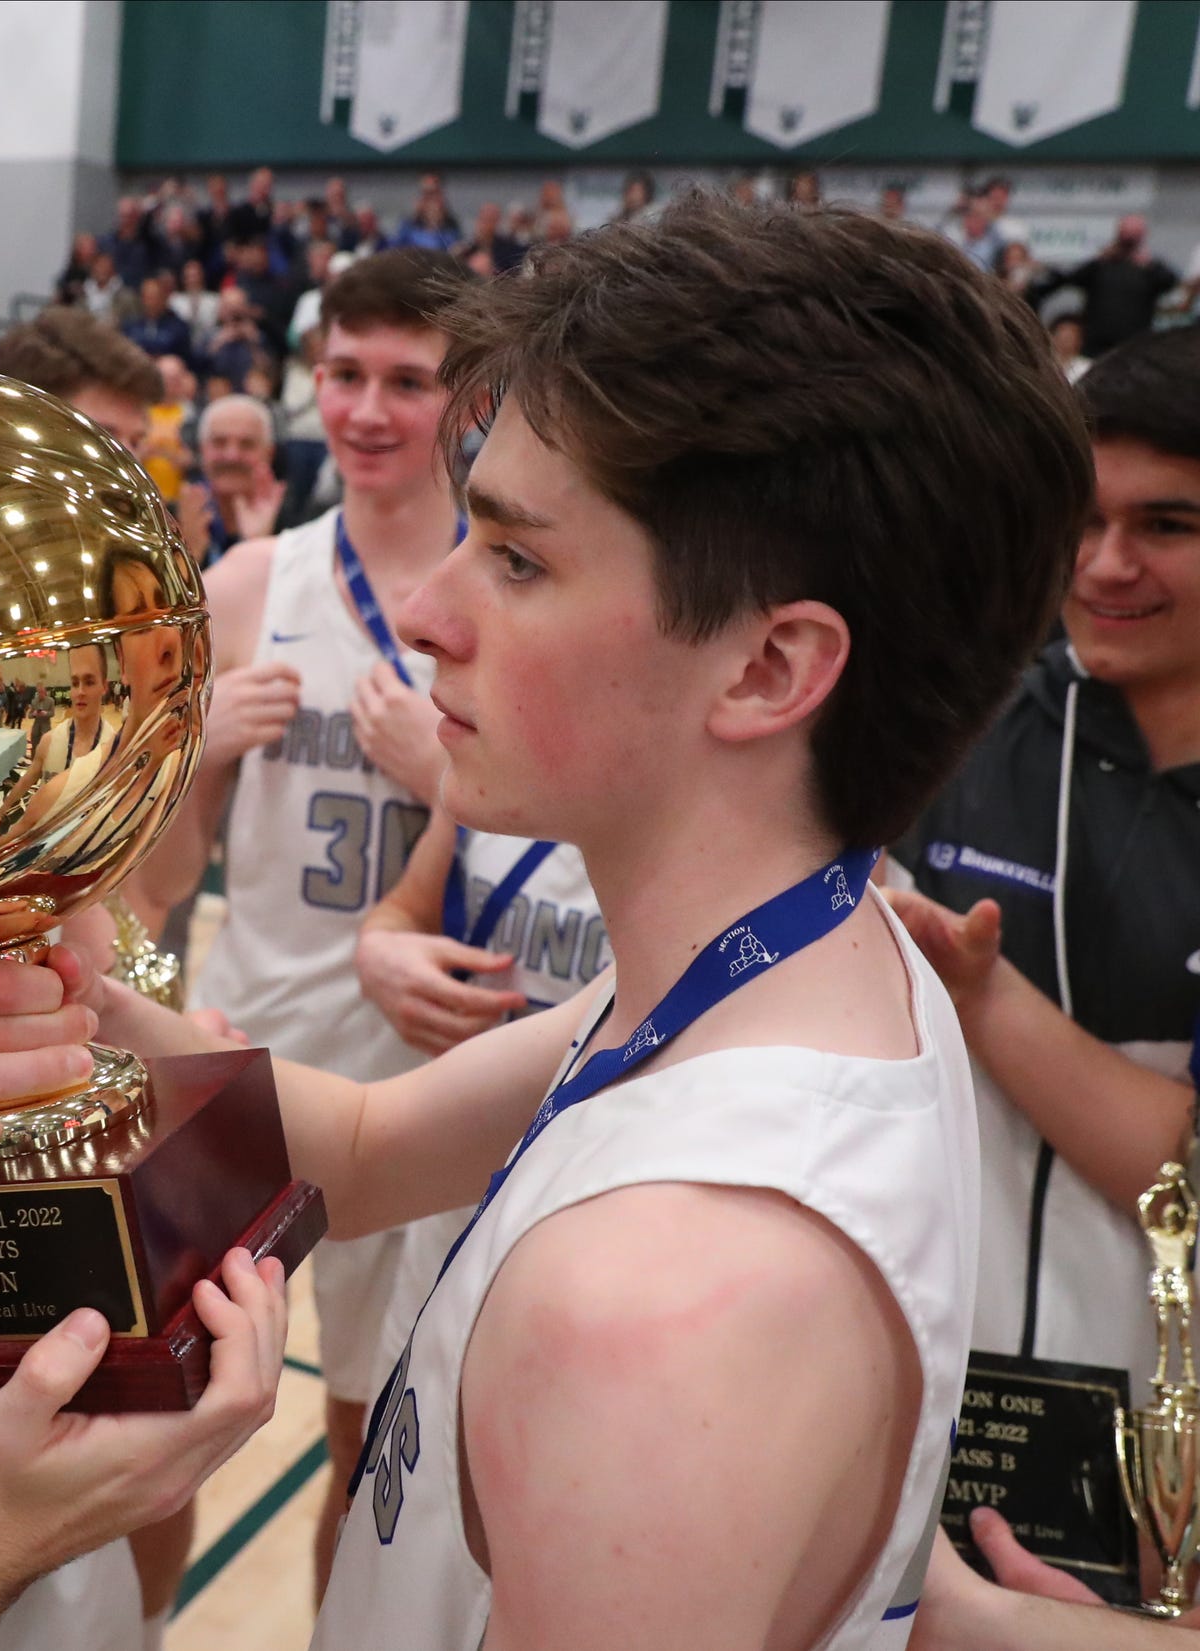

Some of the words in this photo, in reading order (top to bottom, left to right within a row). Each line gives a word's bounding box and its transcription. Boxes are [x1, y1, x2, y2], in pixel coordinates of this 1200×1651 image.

[1000, 1394, 1046, 1416] ONE
[1000, 1452, 1016, 1472] B
[948, 1478, 1008, 1505] MVP
